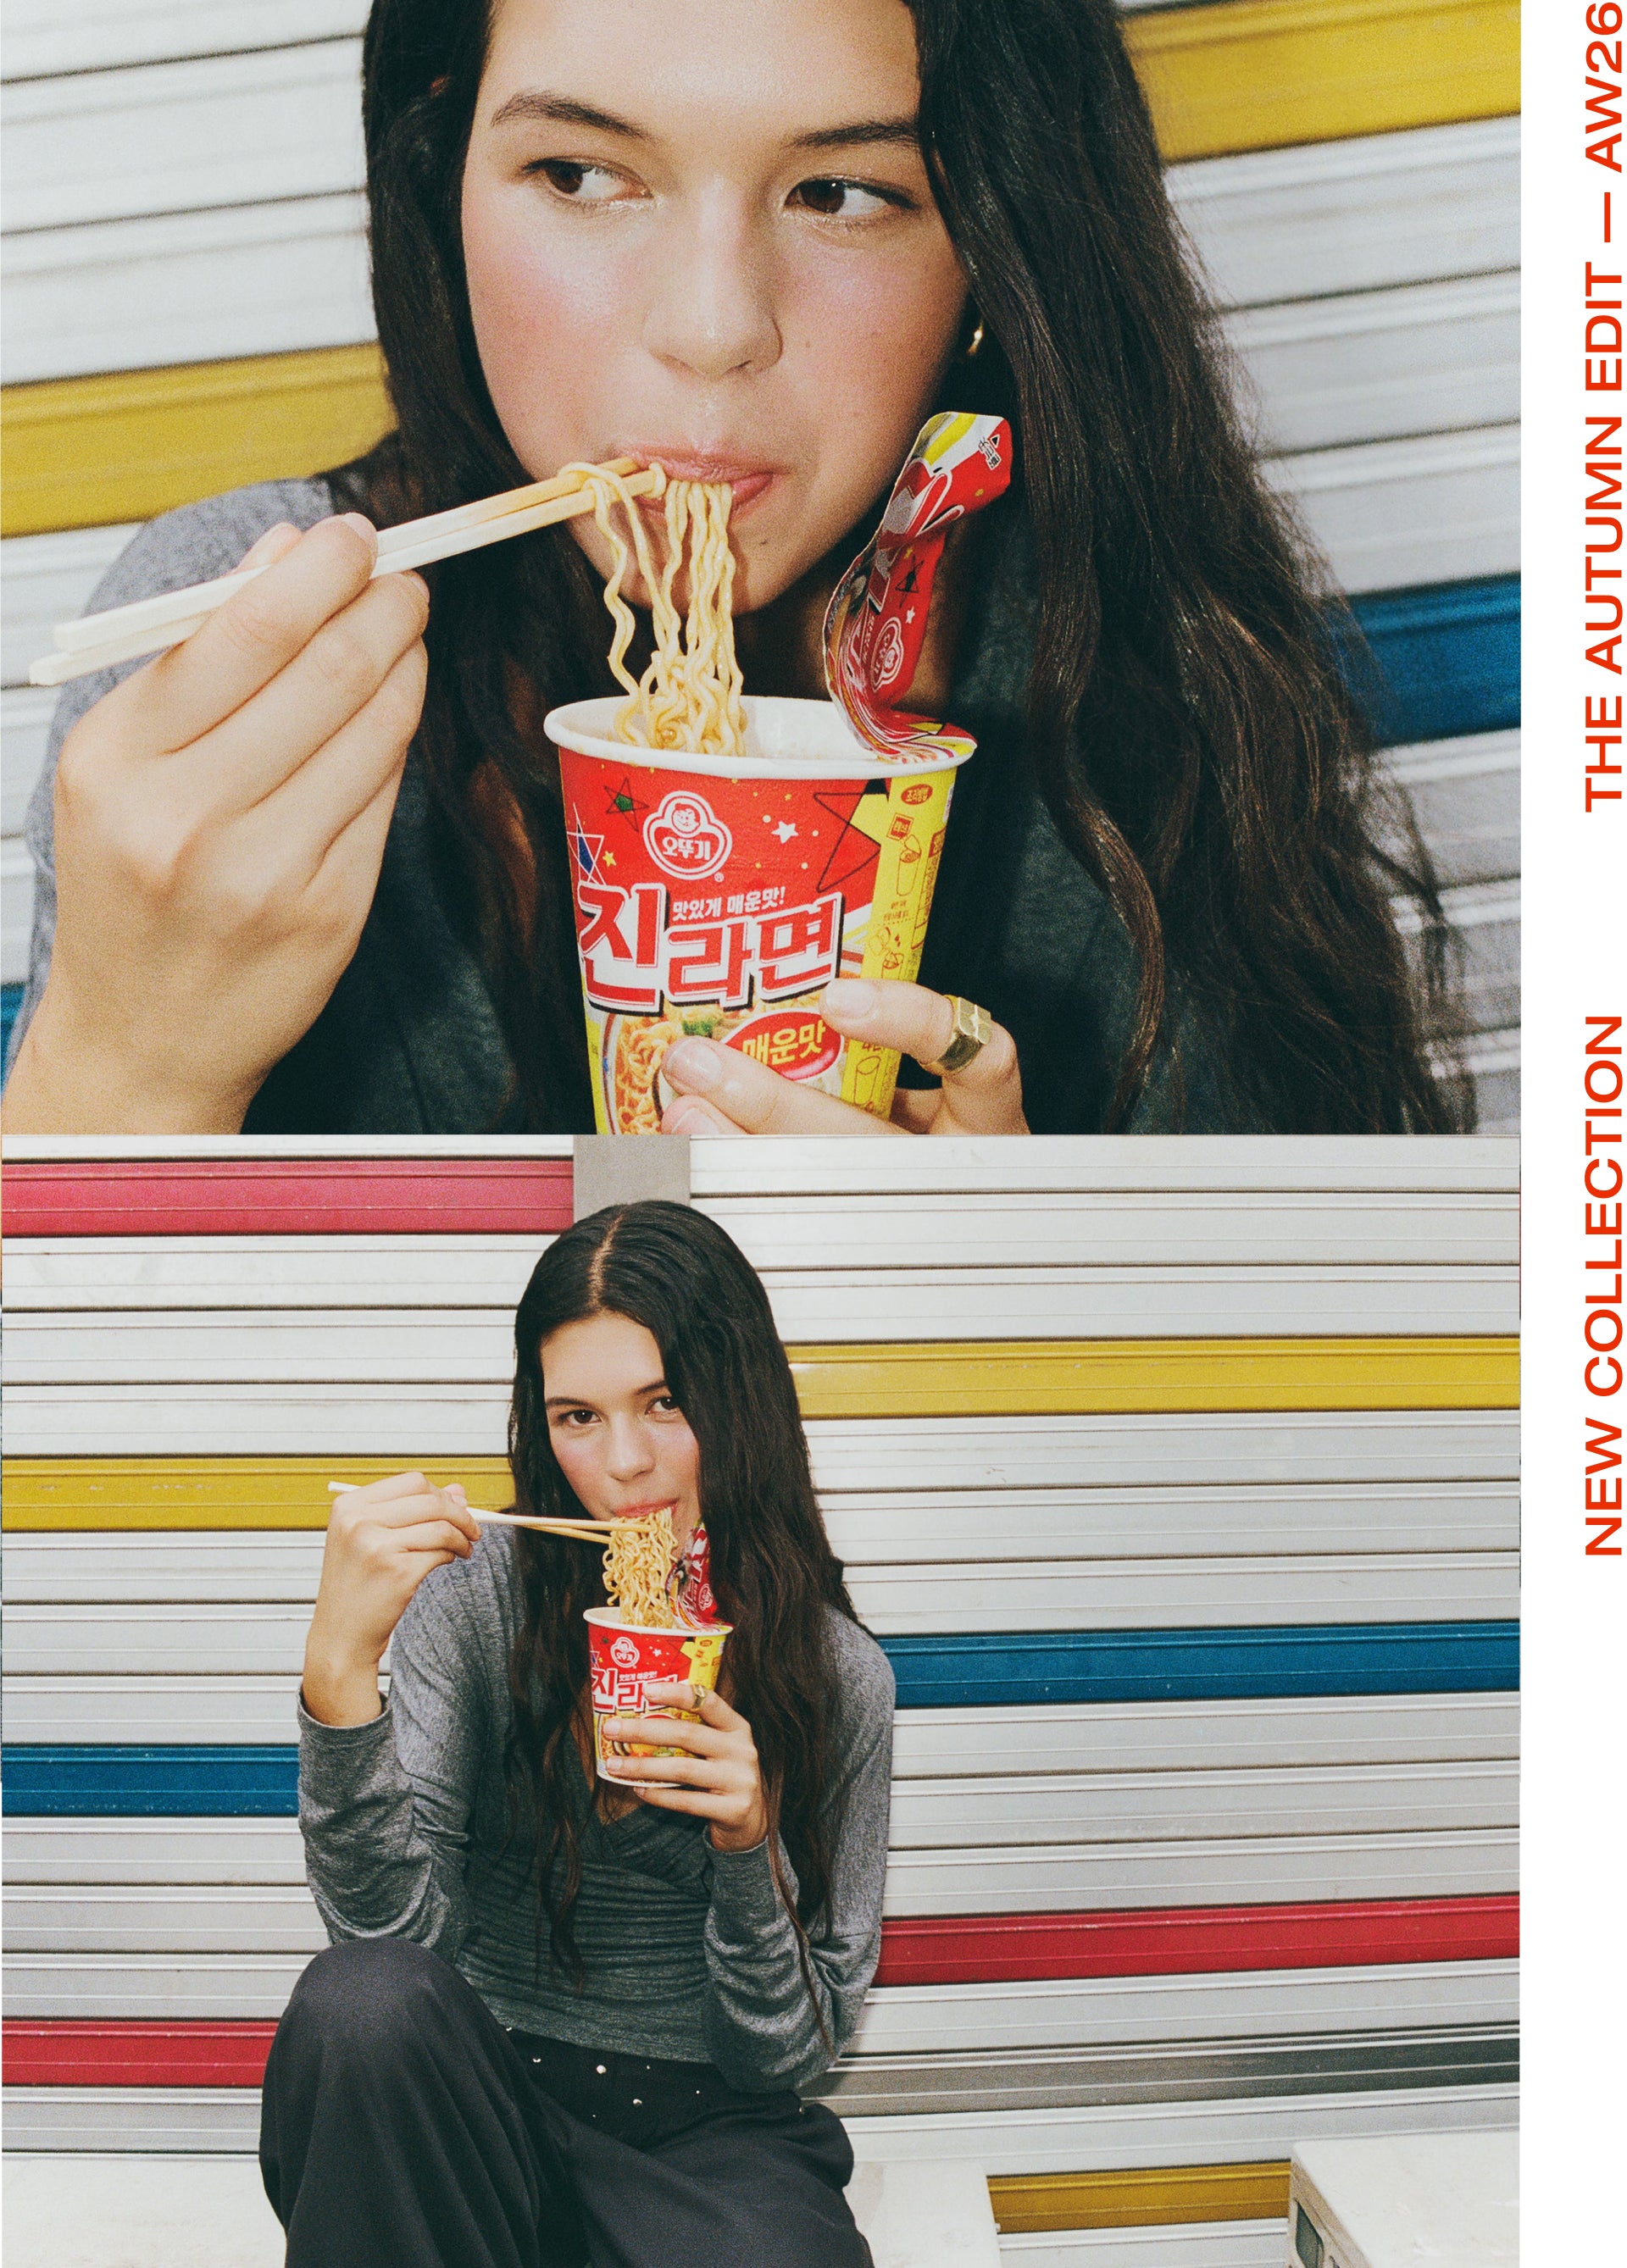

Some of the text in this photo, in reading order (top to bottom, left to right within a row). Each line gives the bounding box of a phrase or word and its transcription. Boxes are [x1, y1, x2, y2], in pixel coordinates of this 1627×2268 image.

[662, 836, 711, 861] 오뚜기
[672, 885, 786, 922] 맛있게 매운맛!
[578, 883, 842, 1012] 진라면
[742, 1019, 826, 1066] 매운맛
[591, 1667, 678, 1713] 진라
